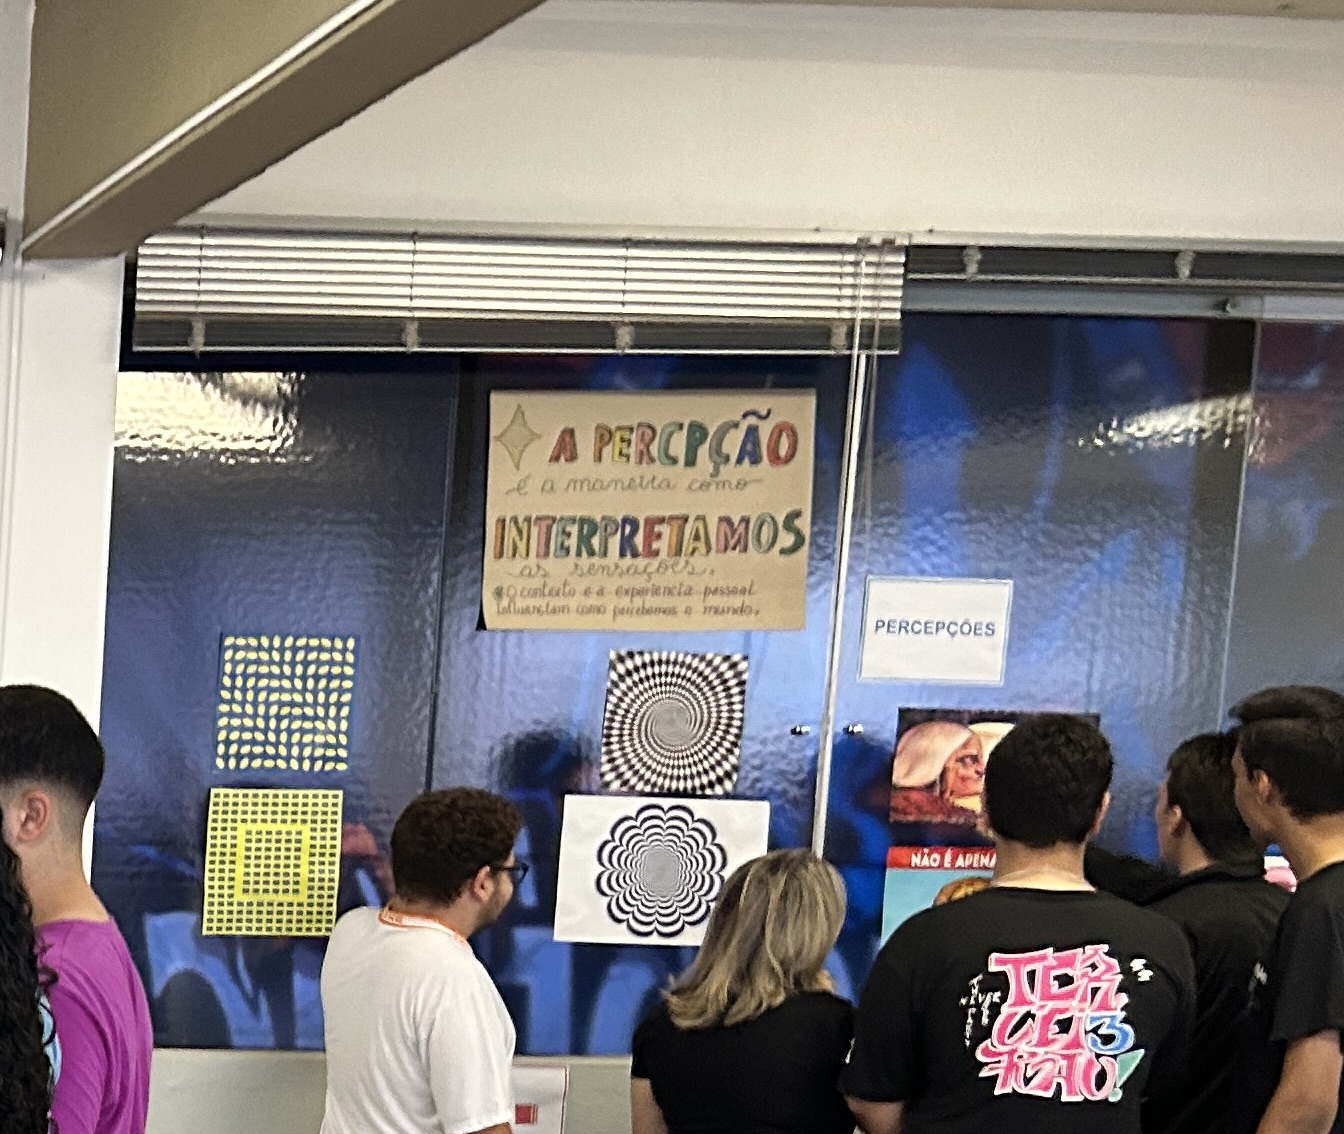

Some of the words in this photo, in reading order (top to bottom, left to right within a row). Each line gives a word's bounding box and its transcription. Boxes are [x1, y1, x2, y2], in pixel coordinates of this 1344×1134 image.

[548, 426, 579, 464] A
[593, 408, 799, 478] PERCPÇÃO
[541, 477, 557, 494] a
[564, 474, 674, 494] maneira
[687, 477, 762, 493] como
[492, 508, 807, 560] INTERPRETAMOS
[508, 562, 551, 579] as
[874, 618, 996, 639] PERCEPÇÕES
[911, 847, 942, 868] NÃO
[943, 847, 953, 868] É
